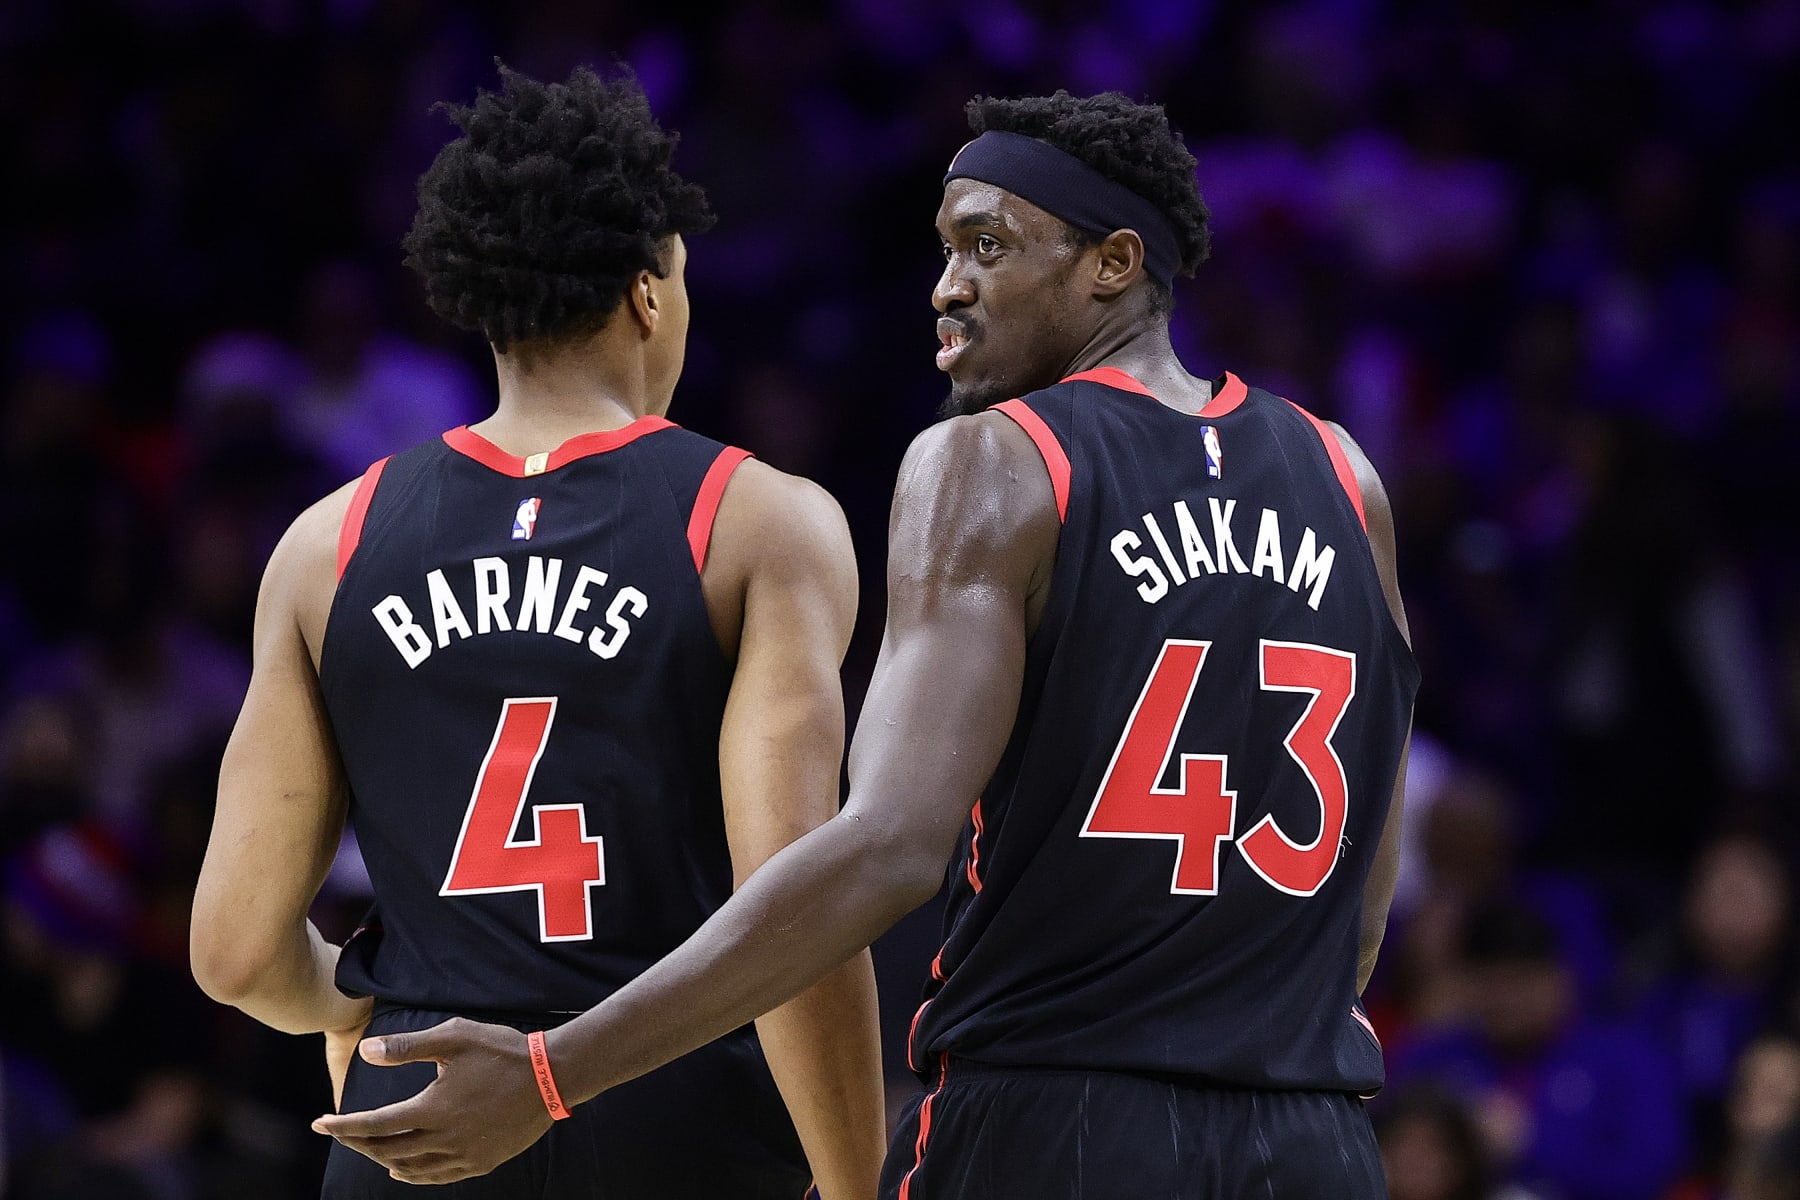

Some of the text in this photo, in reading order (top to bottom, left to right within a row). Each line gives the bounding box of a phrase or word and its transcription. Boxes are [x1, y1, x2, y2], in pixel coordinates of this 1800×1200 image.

[1110, 497, 1336, 611] SIAKAM
[372, 556, 649, 669] BARNES
[439, 696, 605, 943] 4
[1079, 638, 1357, 898] 43
[531, 1036, 545, 1066] HUSTLE
[538, 1068, 556, 1102] HUMBLE
